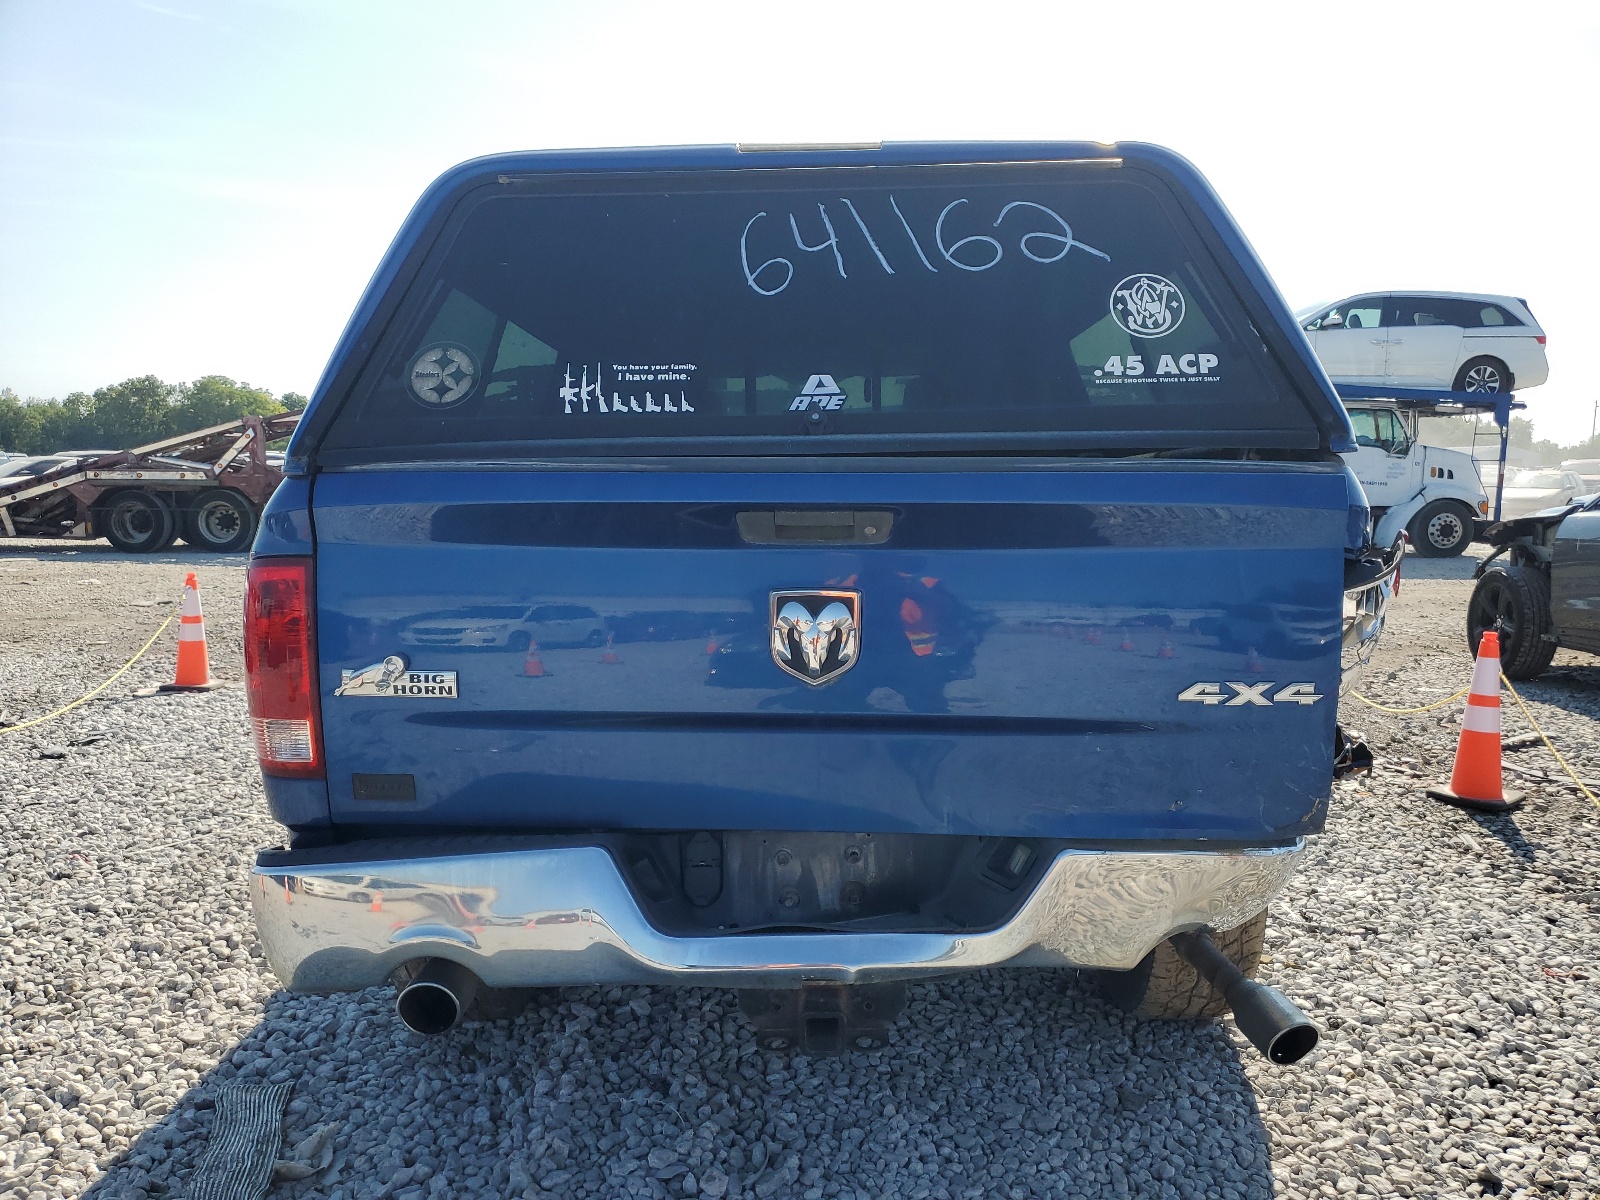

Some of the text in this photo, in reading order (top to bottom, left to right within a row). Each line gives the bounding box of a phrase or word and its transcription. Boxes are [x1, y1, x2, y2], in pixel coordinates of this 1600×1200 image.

[740, 194, 1111, 296] 641162
[612, 363, 628, 371] You
[629, 363, 649, 371] have
[670, 363, 698, 371] family.
[1094, 353, 1219, 377] .45 ACP
[415, 370, 440, 378] Steelers
[617, 371, 691, 381] I have mine.
[409, 673, 446, 684] BIG
[393, 684, 454, 696] HORN
[1177, 681, 1325, 706] 4X4
